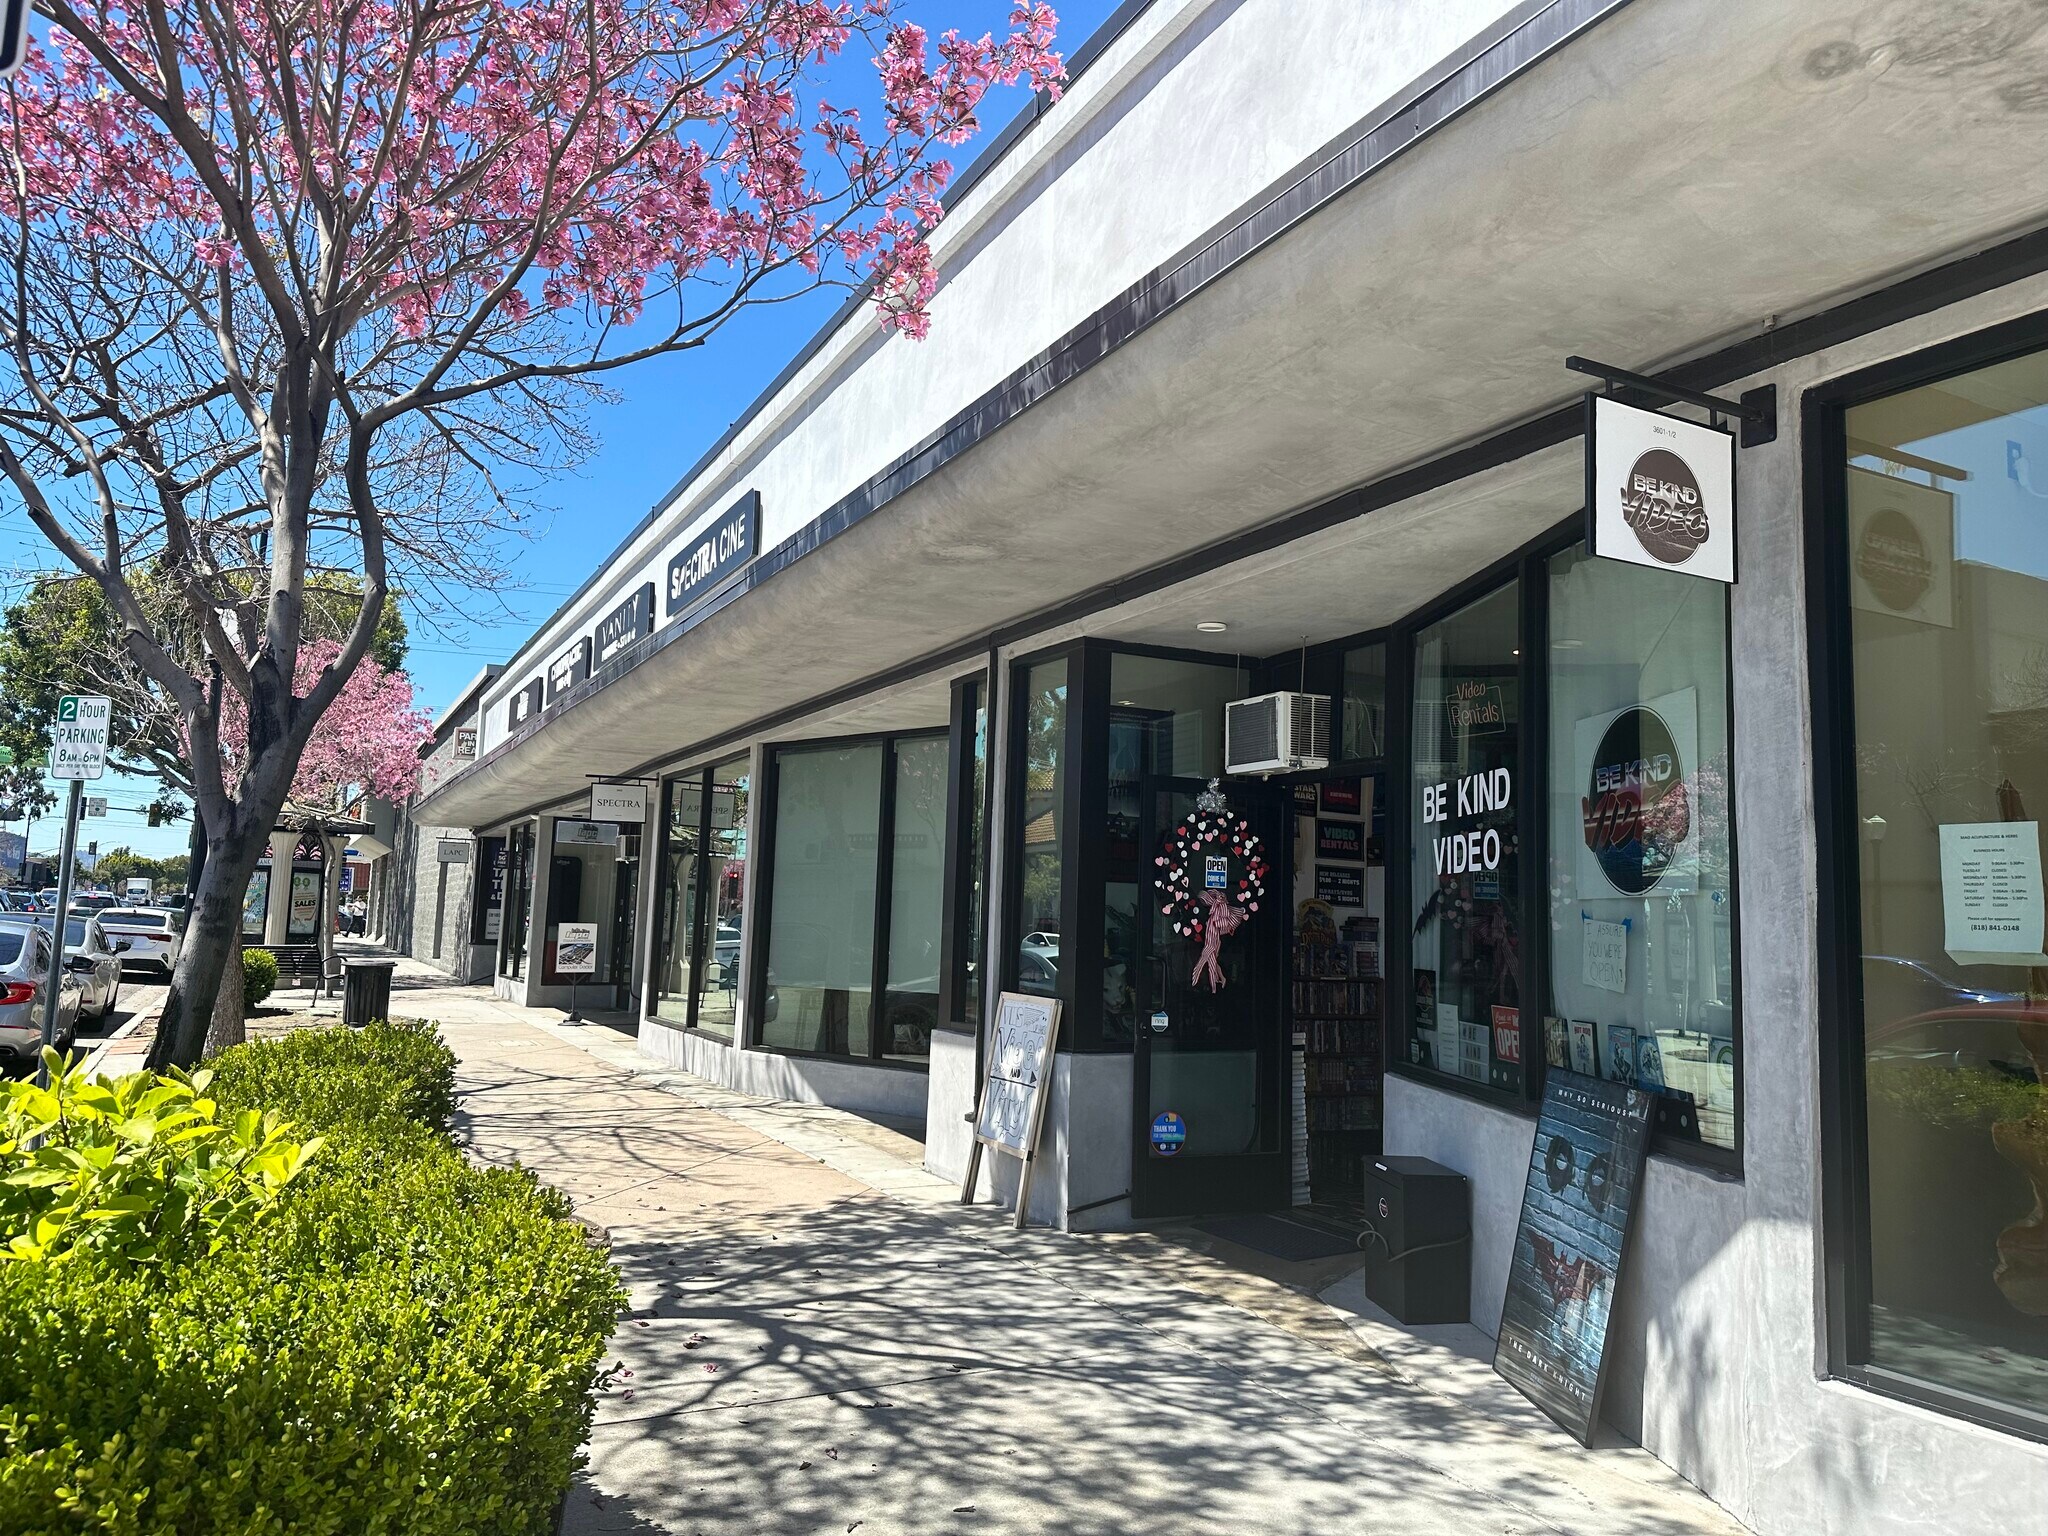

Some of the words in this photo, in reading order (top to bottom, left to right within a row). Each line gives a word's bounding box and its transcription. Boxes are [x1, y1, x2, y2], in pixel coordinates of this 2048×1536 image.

[1652, 425, 1677, 439] 3601-1/2
[1633, 473, 1657, 495] BE
[1659, 480, 1698, 505] KIND
[1620, 487, 1708, 543] VIDEO
[671, 536, 717, 600] SPECTRA
[719, 512, 746, 563] CINE
[602, 594, 640, 646] VANITY
[1456, 681, 1486, 701] Video
[62, 701, 76, 719] 2
[80, 705, 106, 718] HOUR
[1451, 702, 1500, 727] Rentals
[59, 728, 105, 744] PARKING
[459, 732, 477, 740] PAR
[458, 746, 476, 754] REA
[1595, 763, 1622, 793] BE
[1624, 753, 1673, 787] KIND
[1294, 784, 1316, 793] STAR
[1294, 792, 1316, 801] WARS
[1423, 783, 1448, 824] BE
[1457, 767, 1511, 818] KIND
[596, 799, 641, 808] SPECTRA
[1323, 826, 1356, 841] VIDEO
[1320, 839, 1359, 851] RENTALS
[1433, 828, 1500, 876] VIDEO
[1207, 859, 1226, 871] OPEN
[294, 899, 316, 908] SALES
[1586, 925, 1592, 936] I
[1597, 924, 1624, 937] ASSURE
[1588, 941, 1602, 958] YOU
[1589, 961, 1623, 983] OPEN!
[1154, 1017, 1165, 1025] ring
[1573, 1026, 1582, 1035] HOT
[1497, 1027, 1520, 1059] OPE
[1010, 1068, 1021, 1079] AND
[1558, 1089, 1573, 1099] WHY
[1577, 1095, 1586, 1103] SO
[1591, 1099, 1632, 1118] SERIOUS?
[1153, 1125, 1167, 1133] THANK
[1167, 1125, 1177, 1133] YOU
[1508, 1336, 1523, 1353] THE
[1526, 1350, 1549, 1372] DARK
[1552, 1370, 1586, 1401] KNIGHT
